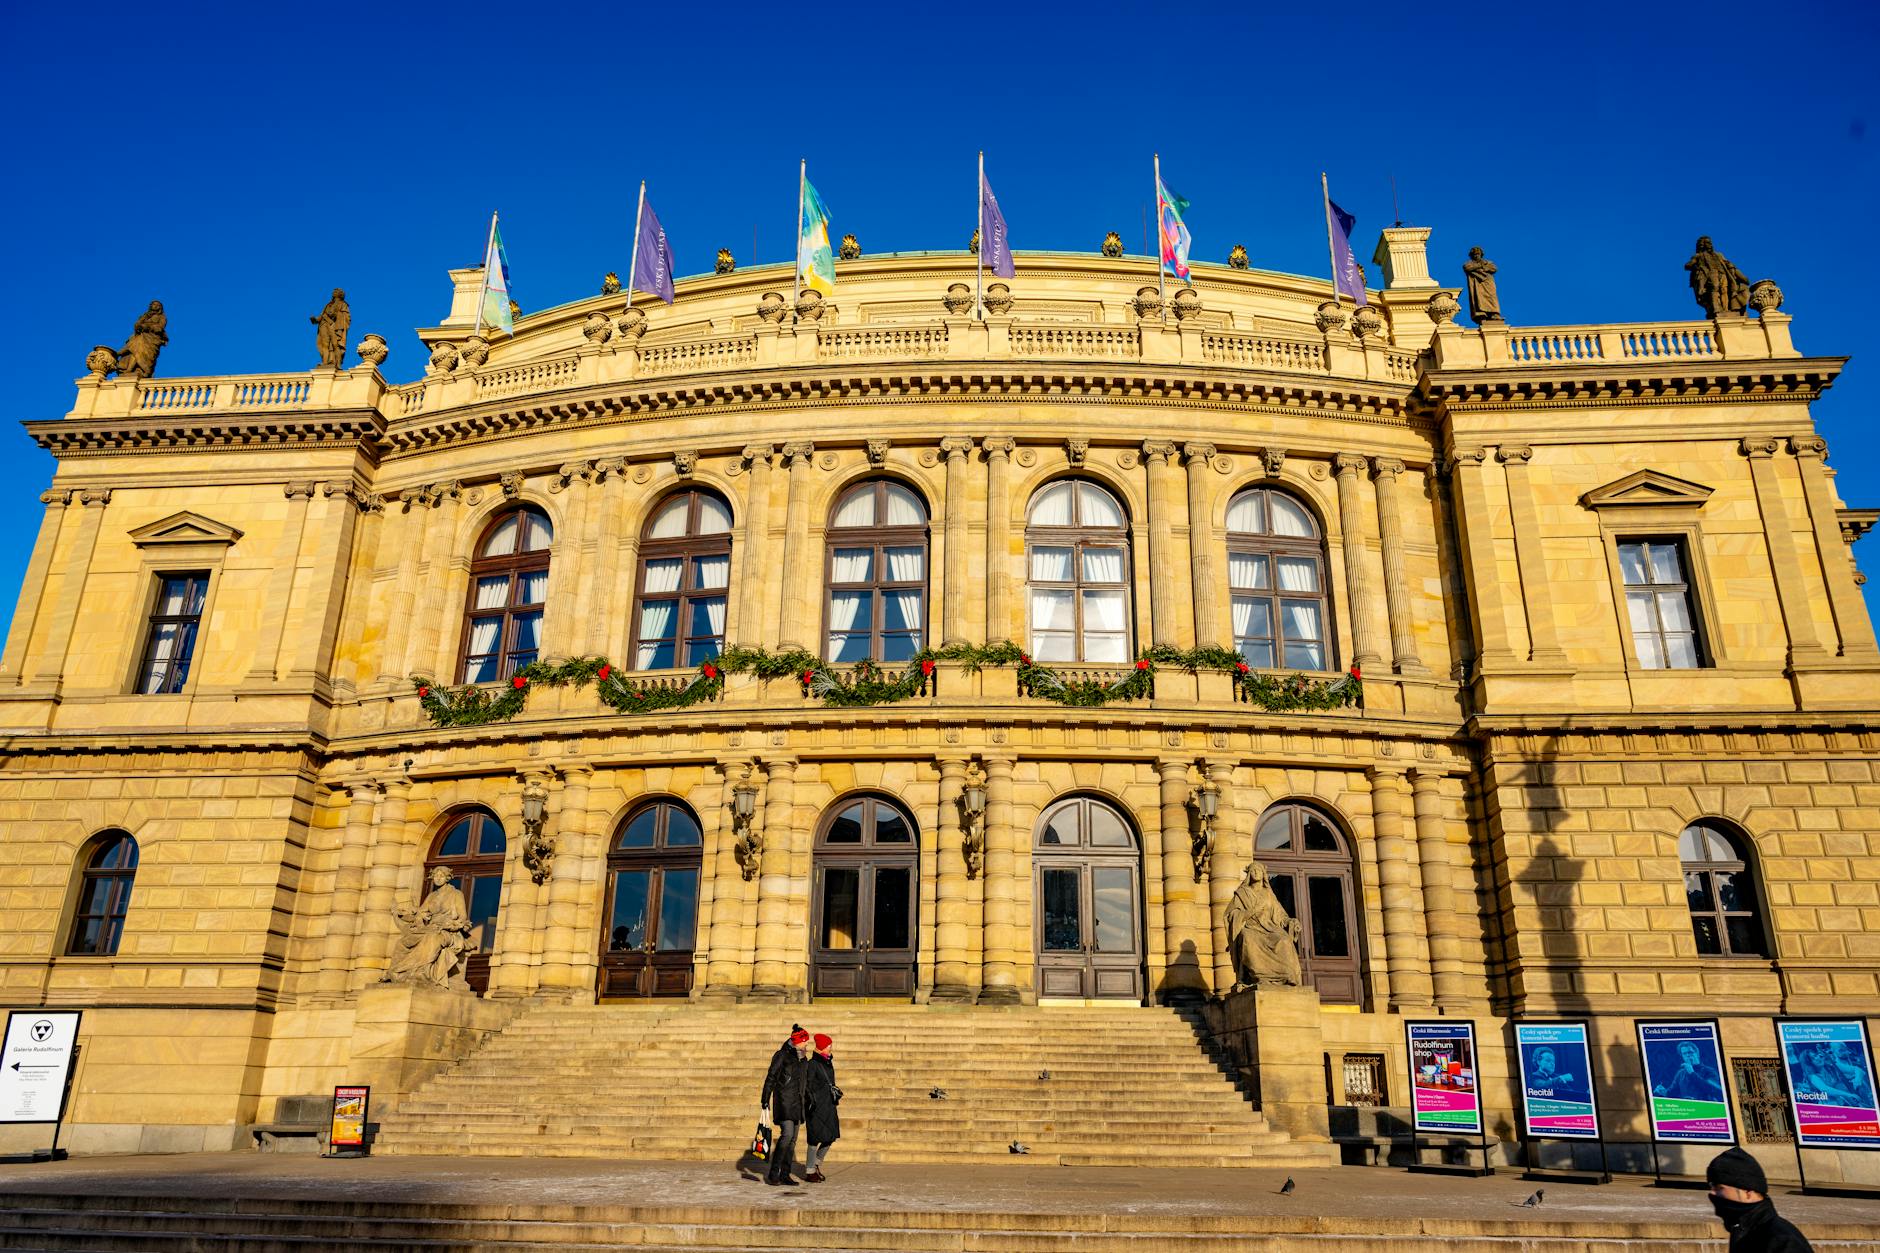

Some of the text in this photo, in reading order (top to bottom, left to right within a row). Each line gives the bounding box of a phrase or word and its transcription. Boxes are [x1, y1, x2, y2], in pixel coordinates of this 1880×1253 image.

[1413, 1040, 1454, 1049] Rudolfinum
[1414, 1049, 1432, 1058] shop
[1528, 1088, 1554, 1097] Recitál
[1796, 1091, 1828, 1101] Recitál
